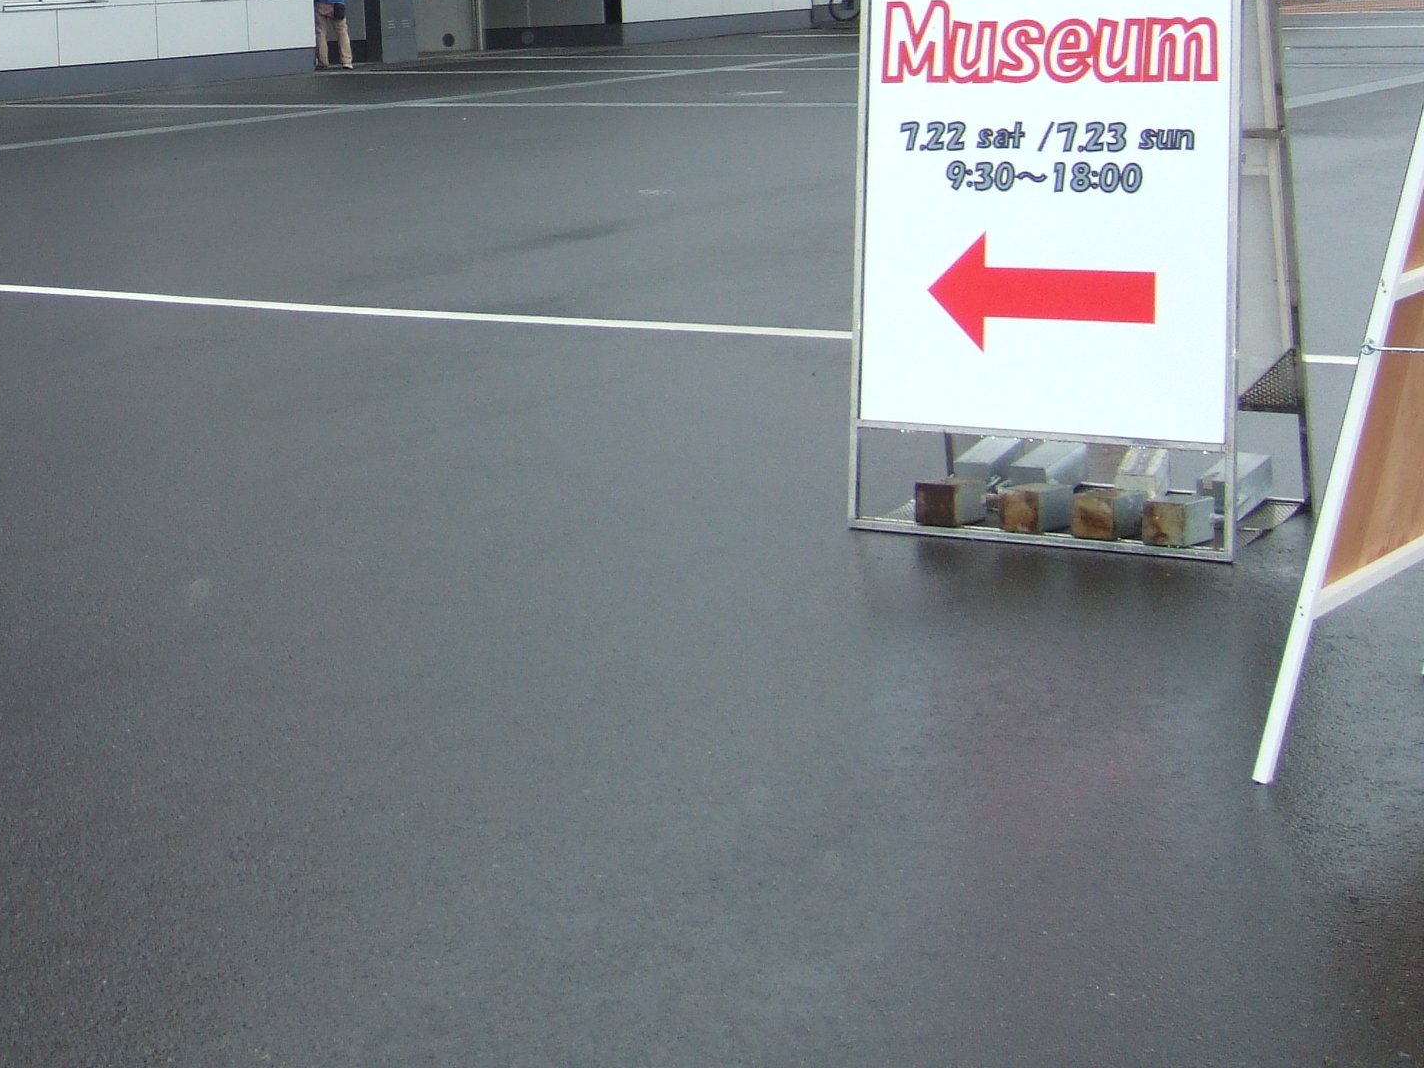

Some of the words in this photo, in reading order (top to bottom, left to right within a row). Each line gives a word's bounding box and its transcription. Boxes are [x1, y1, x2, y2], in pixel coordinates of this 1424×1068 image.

[899, 120, 967, 152] 7.22
[976, 120, 1026, 150] sat
[1137, 127, 1196, 151] sun
